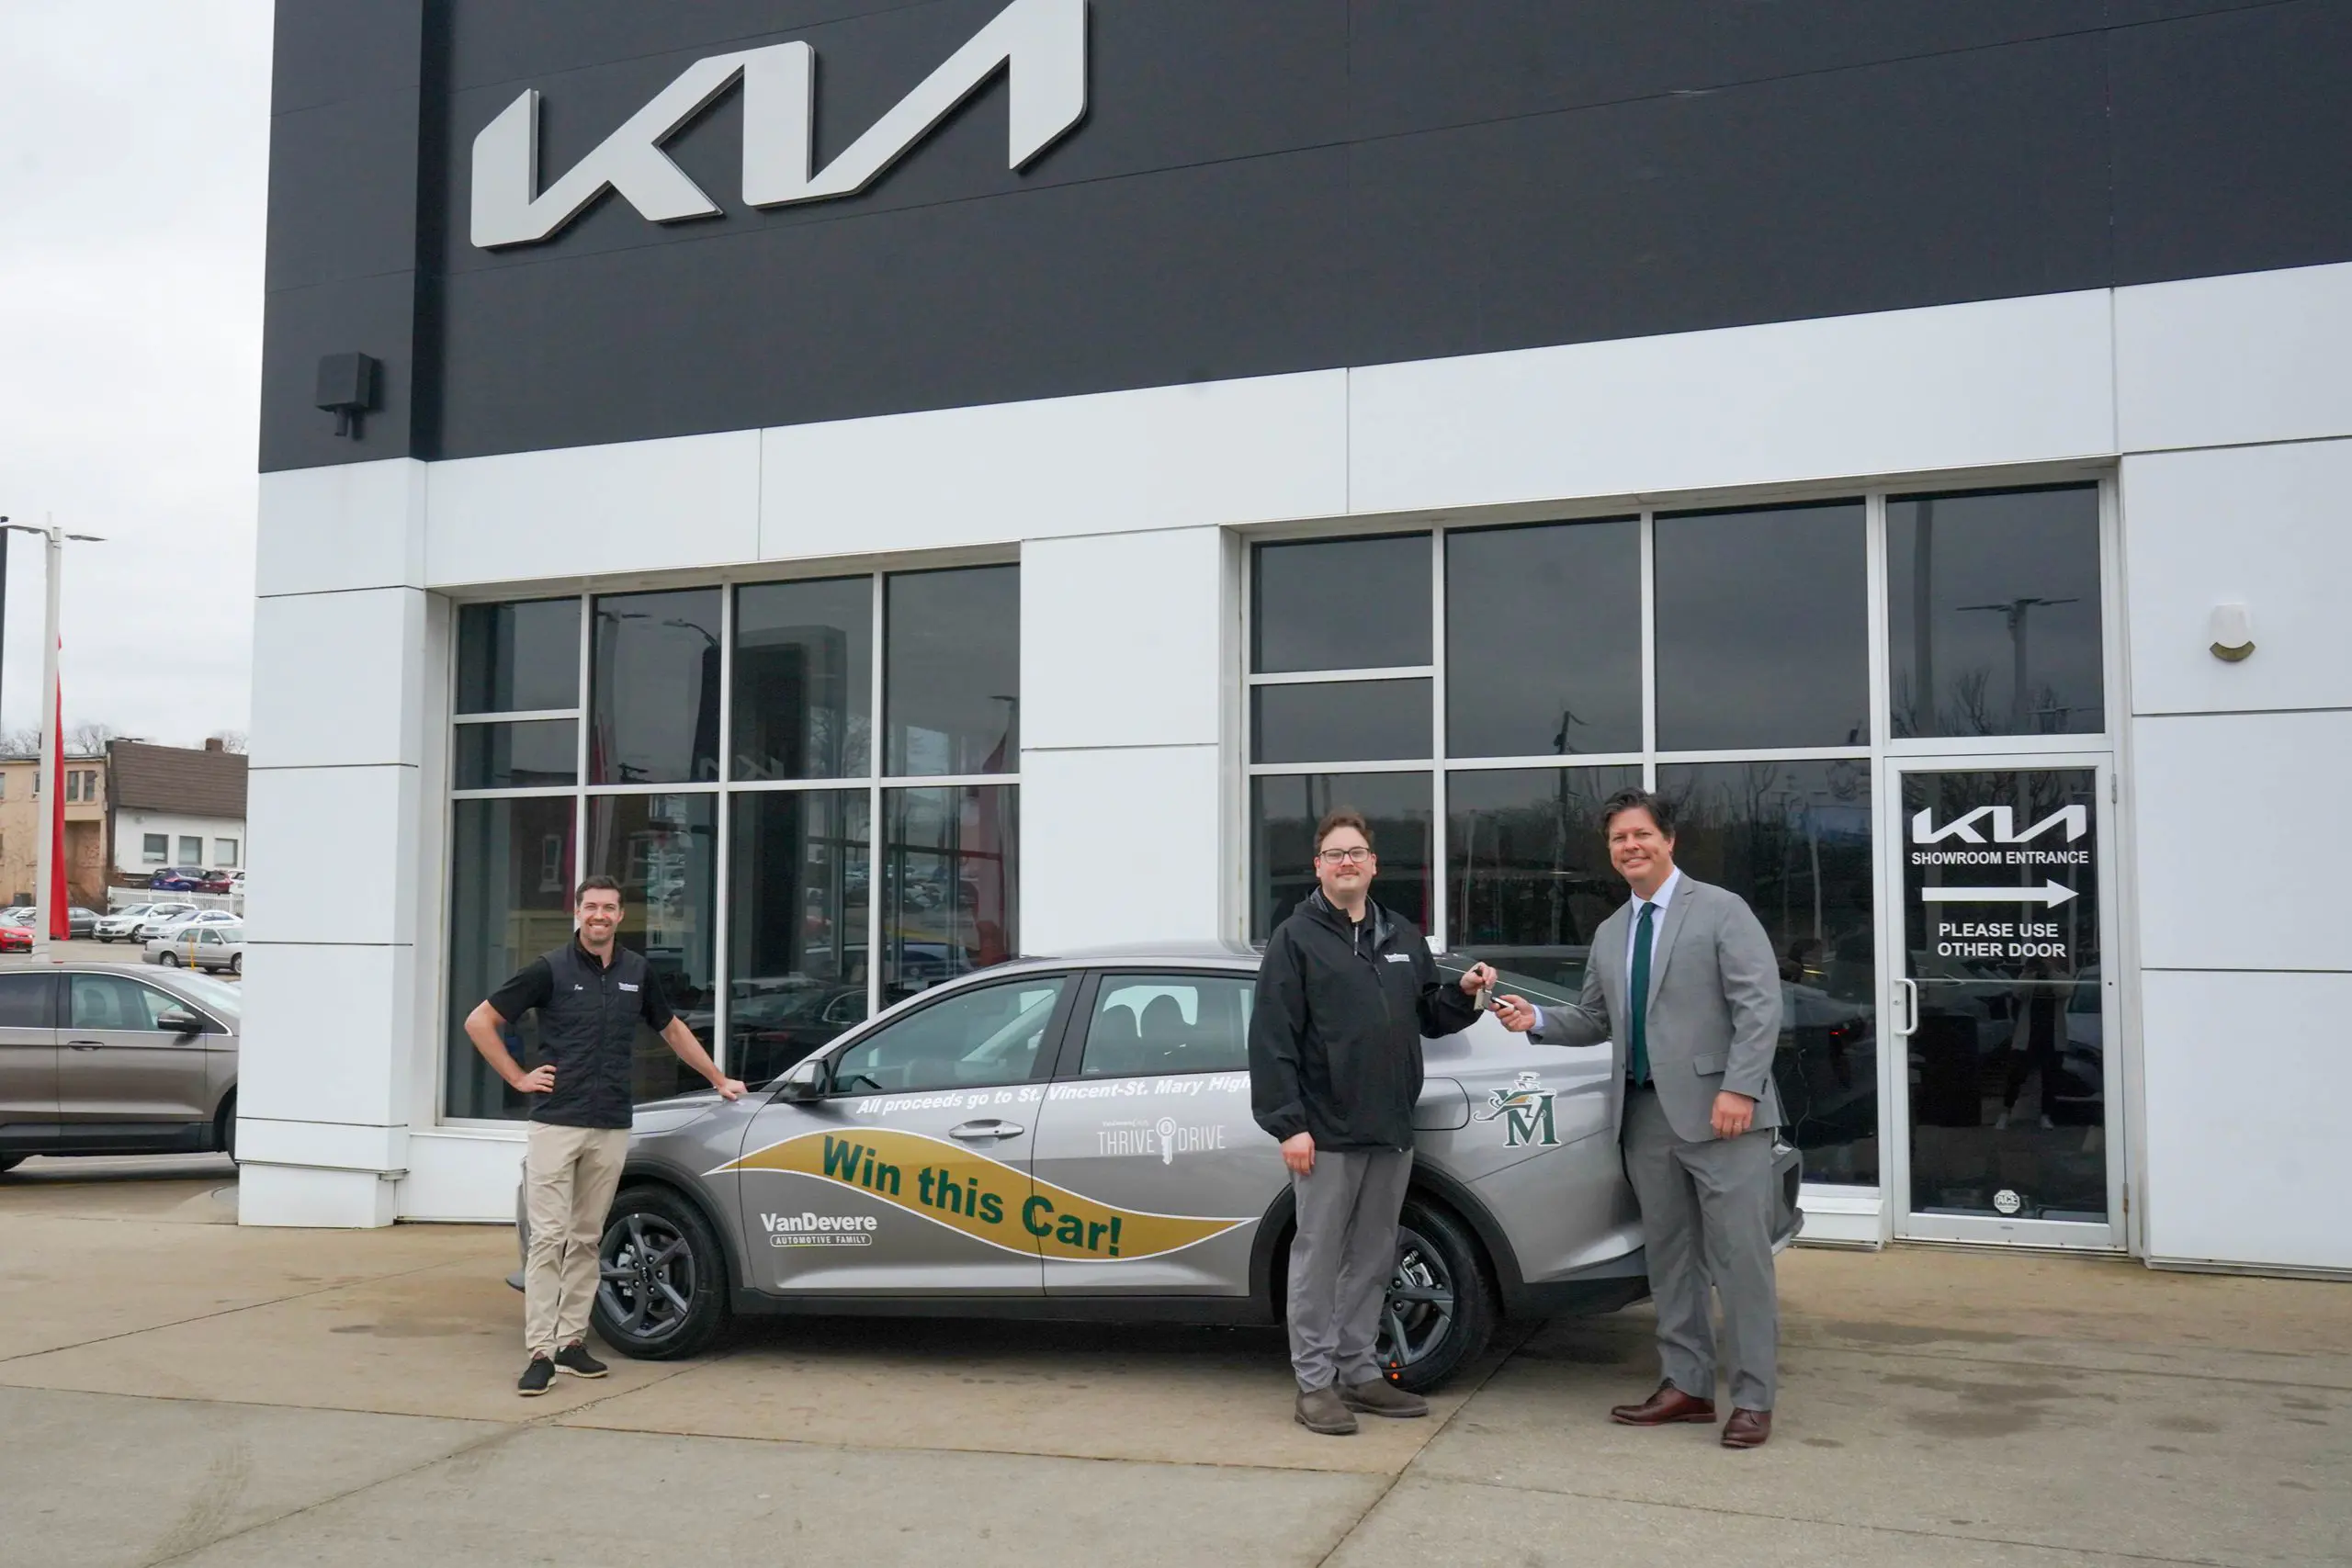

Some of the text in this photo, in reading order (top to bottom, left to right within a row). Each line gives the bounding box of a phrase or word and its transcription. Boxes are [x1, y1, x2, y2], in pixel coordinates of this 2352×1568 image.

[470, 0, 1088, 249] KIA
[1912, 805, 2086, 843] KIA
[1912, 851, 2088, 864] SHOWROOM ENTRANCE
[1939, 922, 2059, 938] PLEASE USE
[1937, 942, 2066, 957] OTHER DOOR
[856, 1074, 1250, 1116] All proceeds go to St. Vincent-St. Mary High
[1097, 1129, 1155, 1155] THRIVE
[1178, 1124, 1227, 1152] DRIVE
[823, 1135, 1123, 1257] Win this Car!
[760, 1212, 878, 1232] VanDevere
[775, 1235, 866, 1245] AUTOMOTIVE FAMILY
